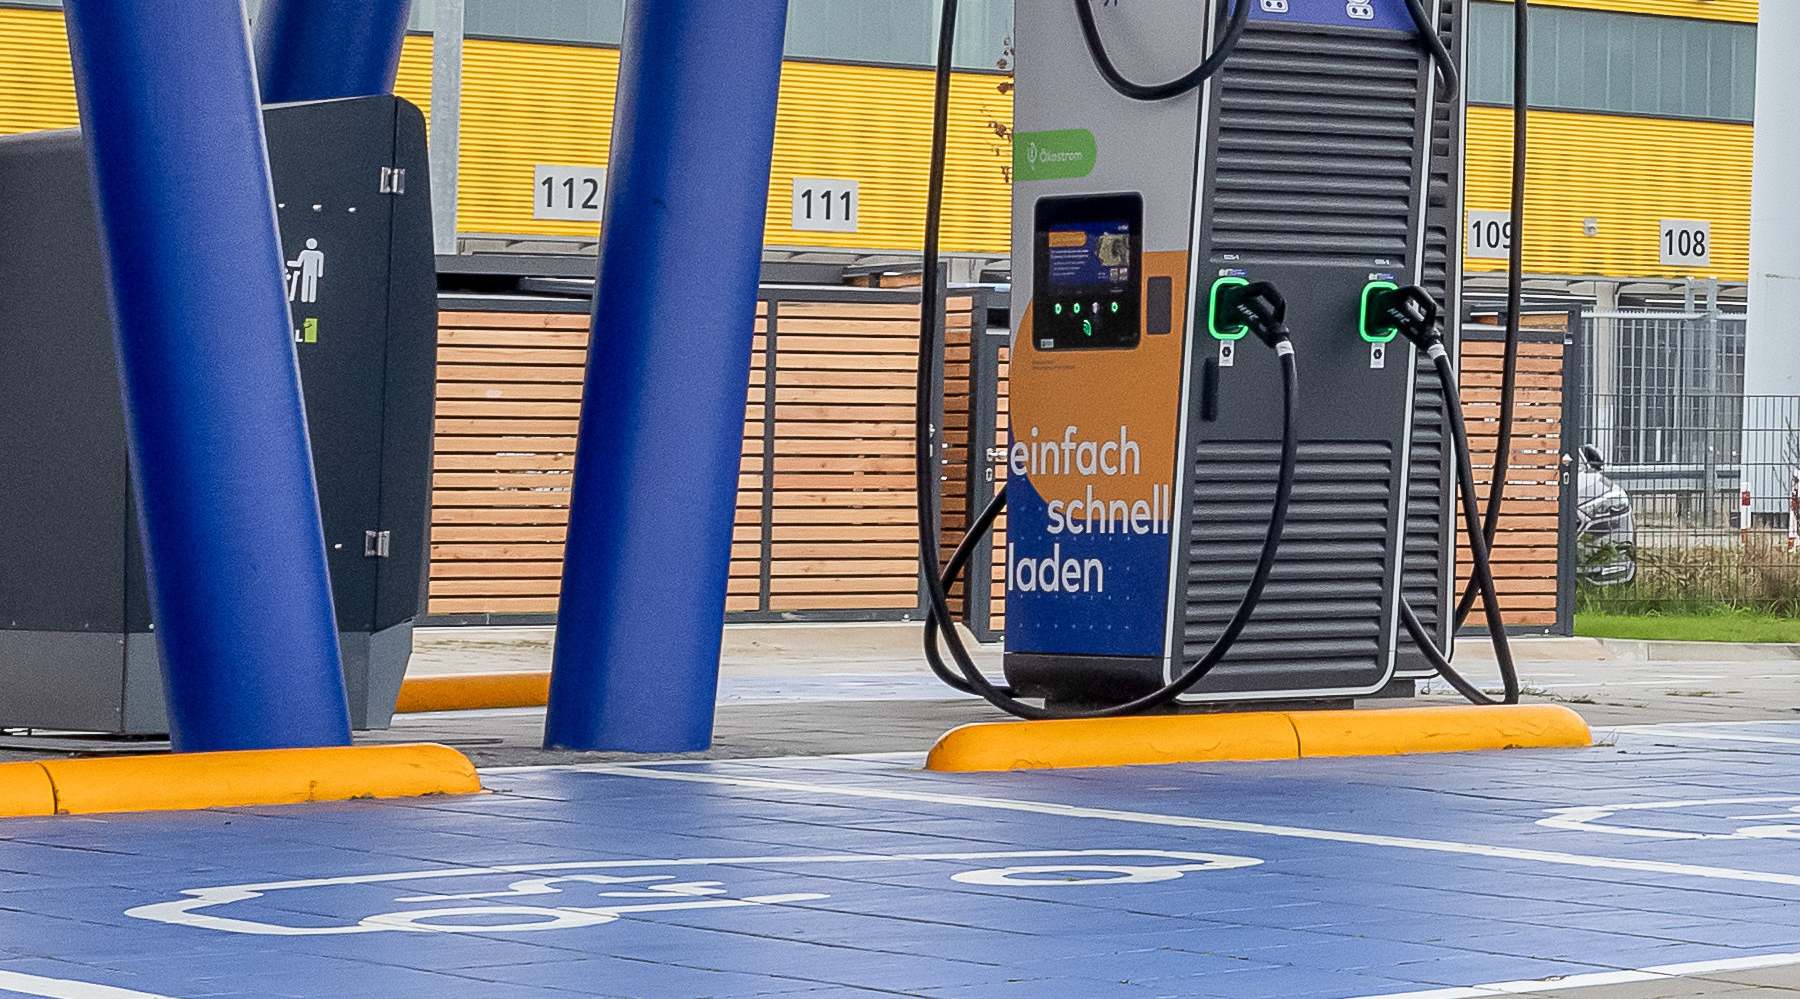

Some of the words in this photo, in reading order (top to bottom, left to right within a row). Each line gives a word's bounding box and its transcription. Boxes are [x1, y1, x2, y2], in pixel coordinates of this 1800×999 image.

[541, 176, 599, 211] 112
[801, 188, 851, 221] 111
[1472, 220, 1511, 250] 109
[1665, 229, 1706, 257] 108
[1010, 425, 1140, 476] einfach
[1046, 484, 1169, 534] schnell
[1007, 542, 1104, 593] laden
